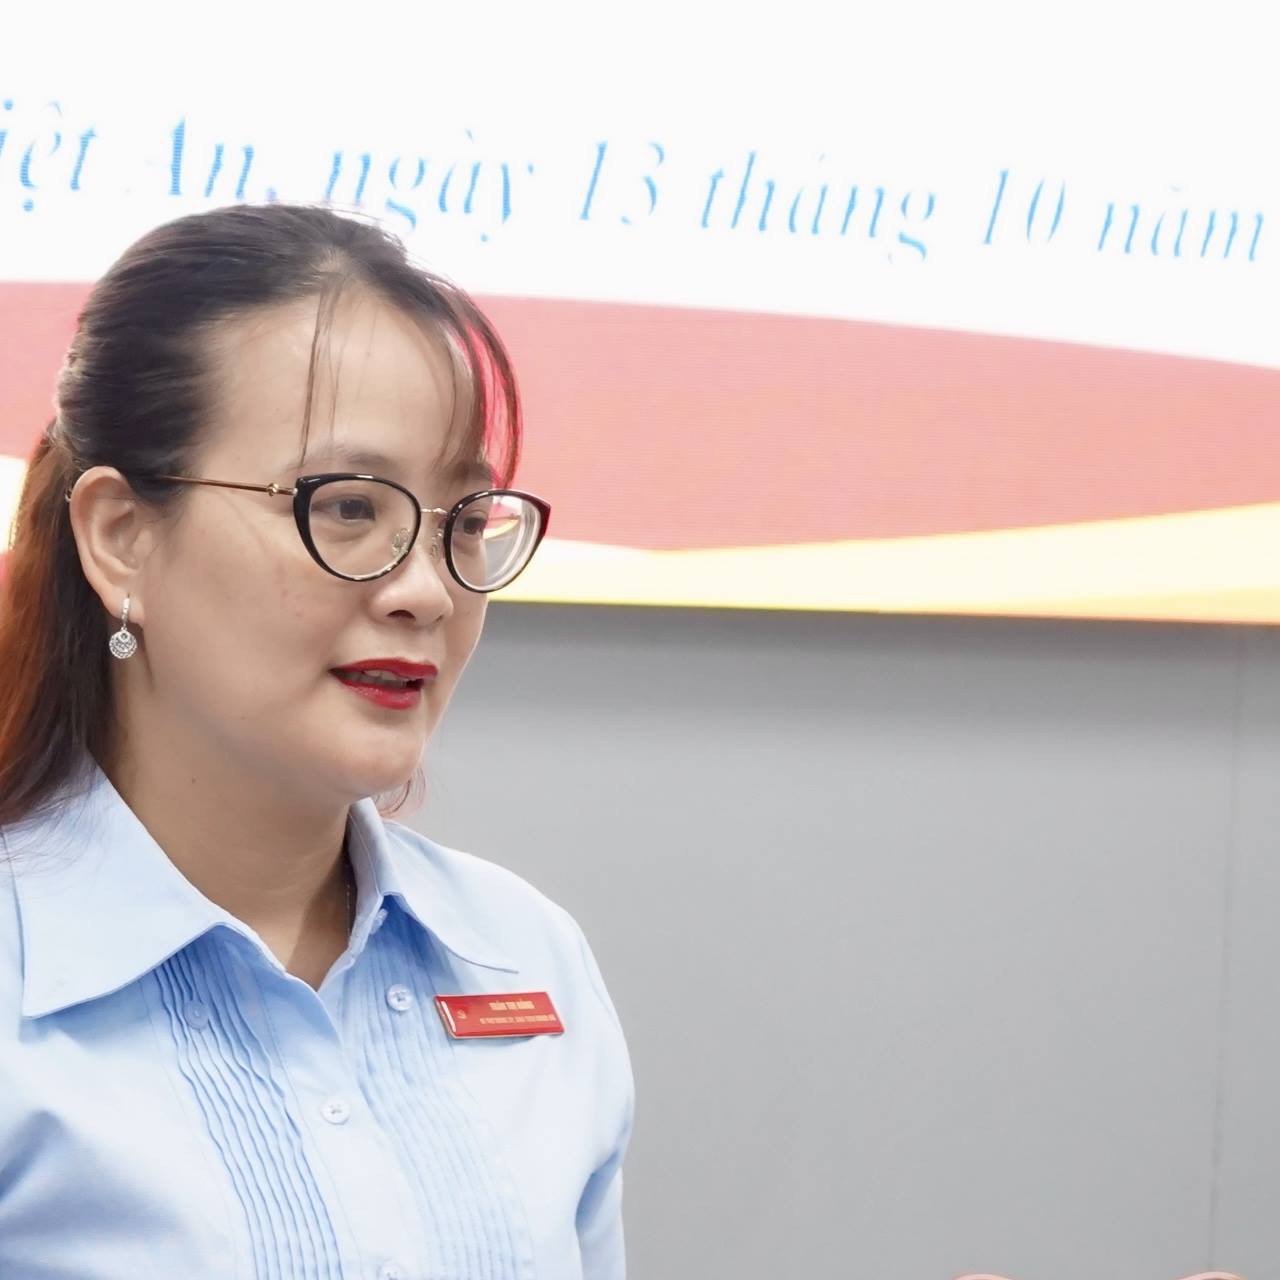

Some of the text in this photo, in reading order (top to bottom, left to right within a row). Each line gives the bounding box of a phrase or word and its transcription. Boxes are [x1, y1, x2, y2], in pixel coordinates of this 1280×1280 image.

[323, 125, 538, 242] ngày
[577, 137, 668, 228] 13
[697, 148, 937, 264] tháng
[980, 166, 1068, 248] 10
[1095, 182, 1267, 264] năm
